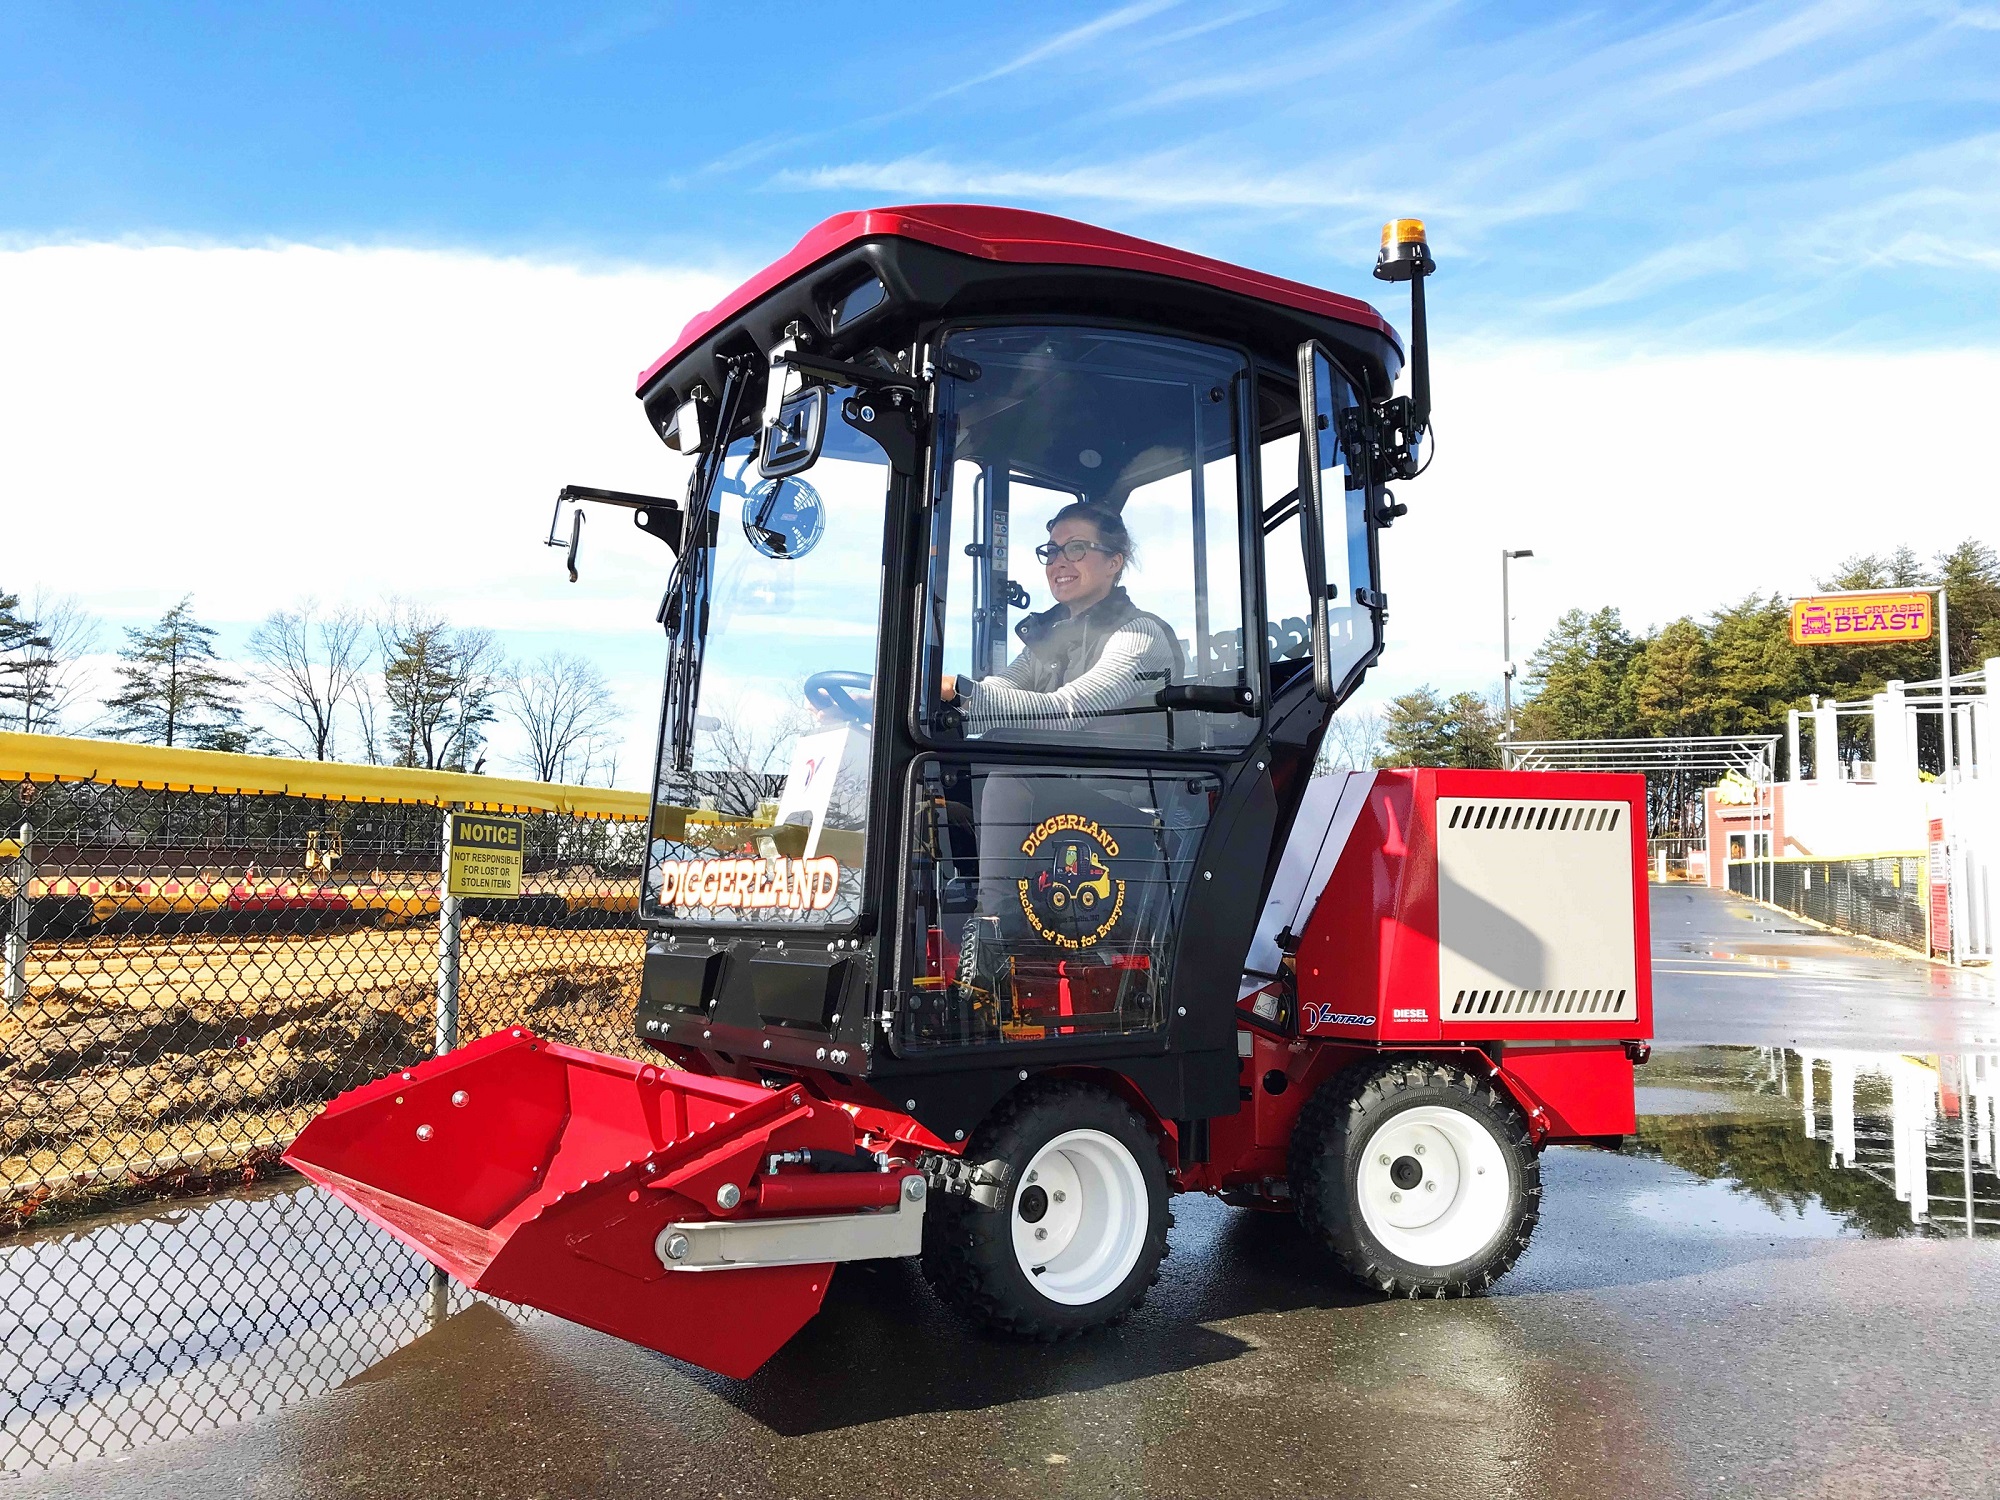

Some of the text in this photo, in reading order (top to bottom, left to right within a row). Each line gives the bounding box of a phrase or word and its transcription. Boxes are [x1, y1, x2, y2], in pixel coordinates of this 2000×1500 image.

[1833, 603, 1926, 615] THE GREASED
[1834, 612, 1924, 632] BEAST
[460, 822, 517, 845] NOTICE
[1021, 813, 1120, 857] DIGGERLAND
[454, 852, 519, 865] NOT RESPONSIBLE
[463, 865, 510, 876] FOR LOST OR
[461, 877, 512, 889] STOLEN ITEMS
[660, 855, 840, 910] DIGGERLAND
[1018, 879, 1043, 931] Buckets
[1042, 928, 1056, 941] of
[1055, 934, 1079, 949] Fun
[1080, 934, 1098, 948] for
[1096, 879, 1126, 938] Everyone!
[1393, 1008, 1429, 1018] DIESEL
